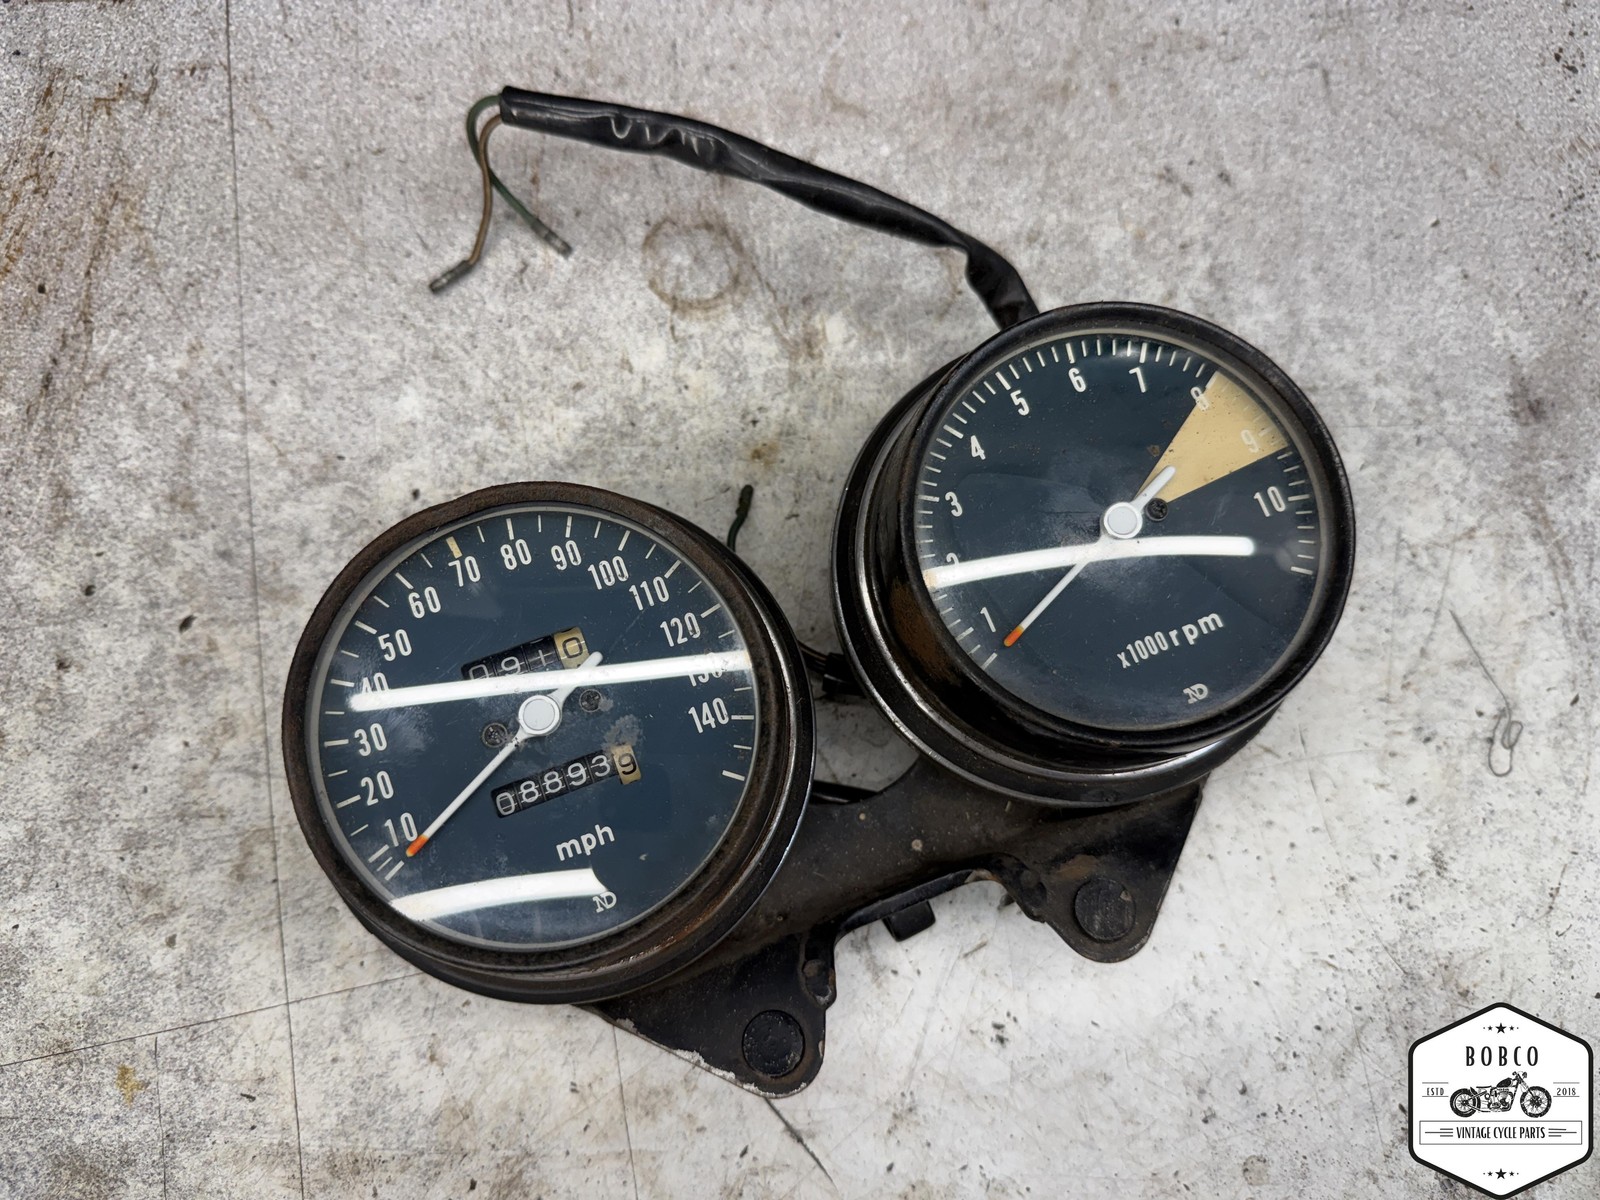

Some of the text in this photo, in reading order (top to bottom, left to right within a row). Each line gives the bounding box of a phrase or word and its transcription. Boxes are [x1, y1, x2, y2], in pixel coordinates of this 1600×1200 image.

[1068, 367, 1087, 392] 6
[1128, 367, 1147, 393] 7
[1010, 389, 1030, 416] 5
[970, 435, 986, 460] 4
[1240, 429, 1259, 453] 9
[945, 491, 963, 517] 3
[1253, 486, 1286, 517] 10
[500, 538, 532, 570] 80
[551, 540, 582, 571] 90
[448, 555, 481, 587] 70
[588, 555, 629, 590] 100
[408, 586, 441, 619] 60
[629, 576, 670, 611] 110
[659, 612, 701, 647] 120
[980, 606, 996, 632] 1
[378, 629, 412, 661] 50
[688, 697, 730, 733] 140
[354, 723, 387, 757] 30
[360, 771, 394, 806] 20
[384, 812, 418, 847] 10
[556, 824, 615, 861] mph
